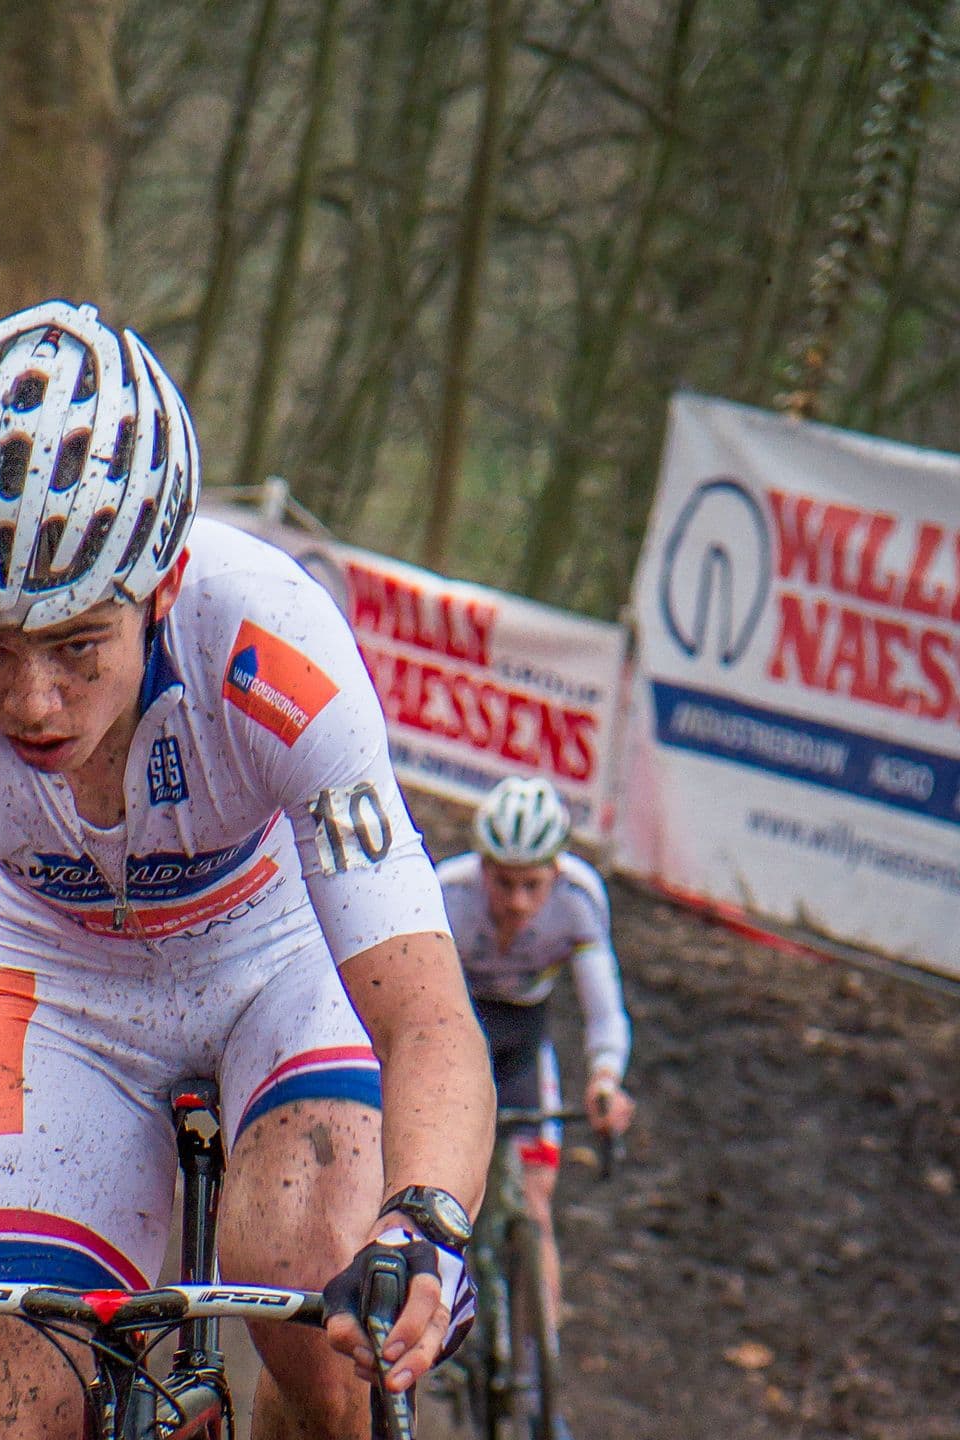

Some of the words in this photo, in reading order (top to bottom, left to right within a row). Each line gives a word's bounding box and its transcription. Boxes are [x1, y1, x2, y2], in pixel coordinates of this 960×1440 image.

[767, 488, 960, 623] WILL
[358, 636, 601, 783] AESSENS
[768, 592, 960, 726] NAES
[309, 780, 393, 875] 10
